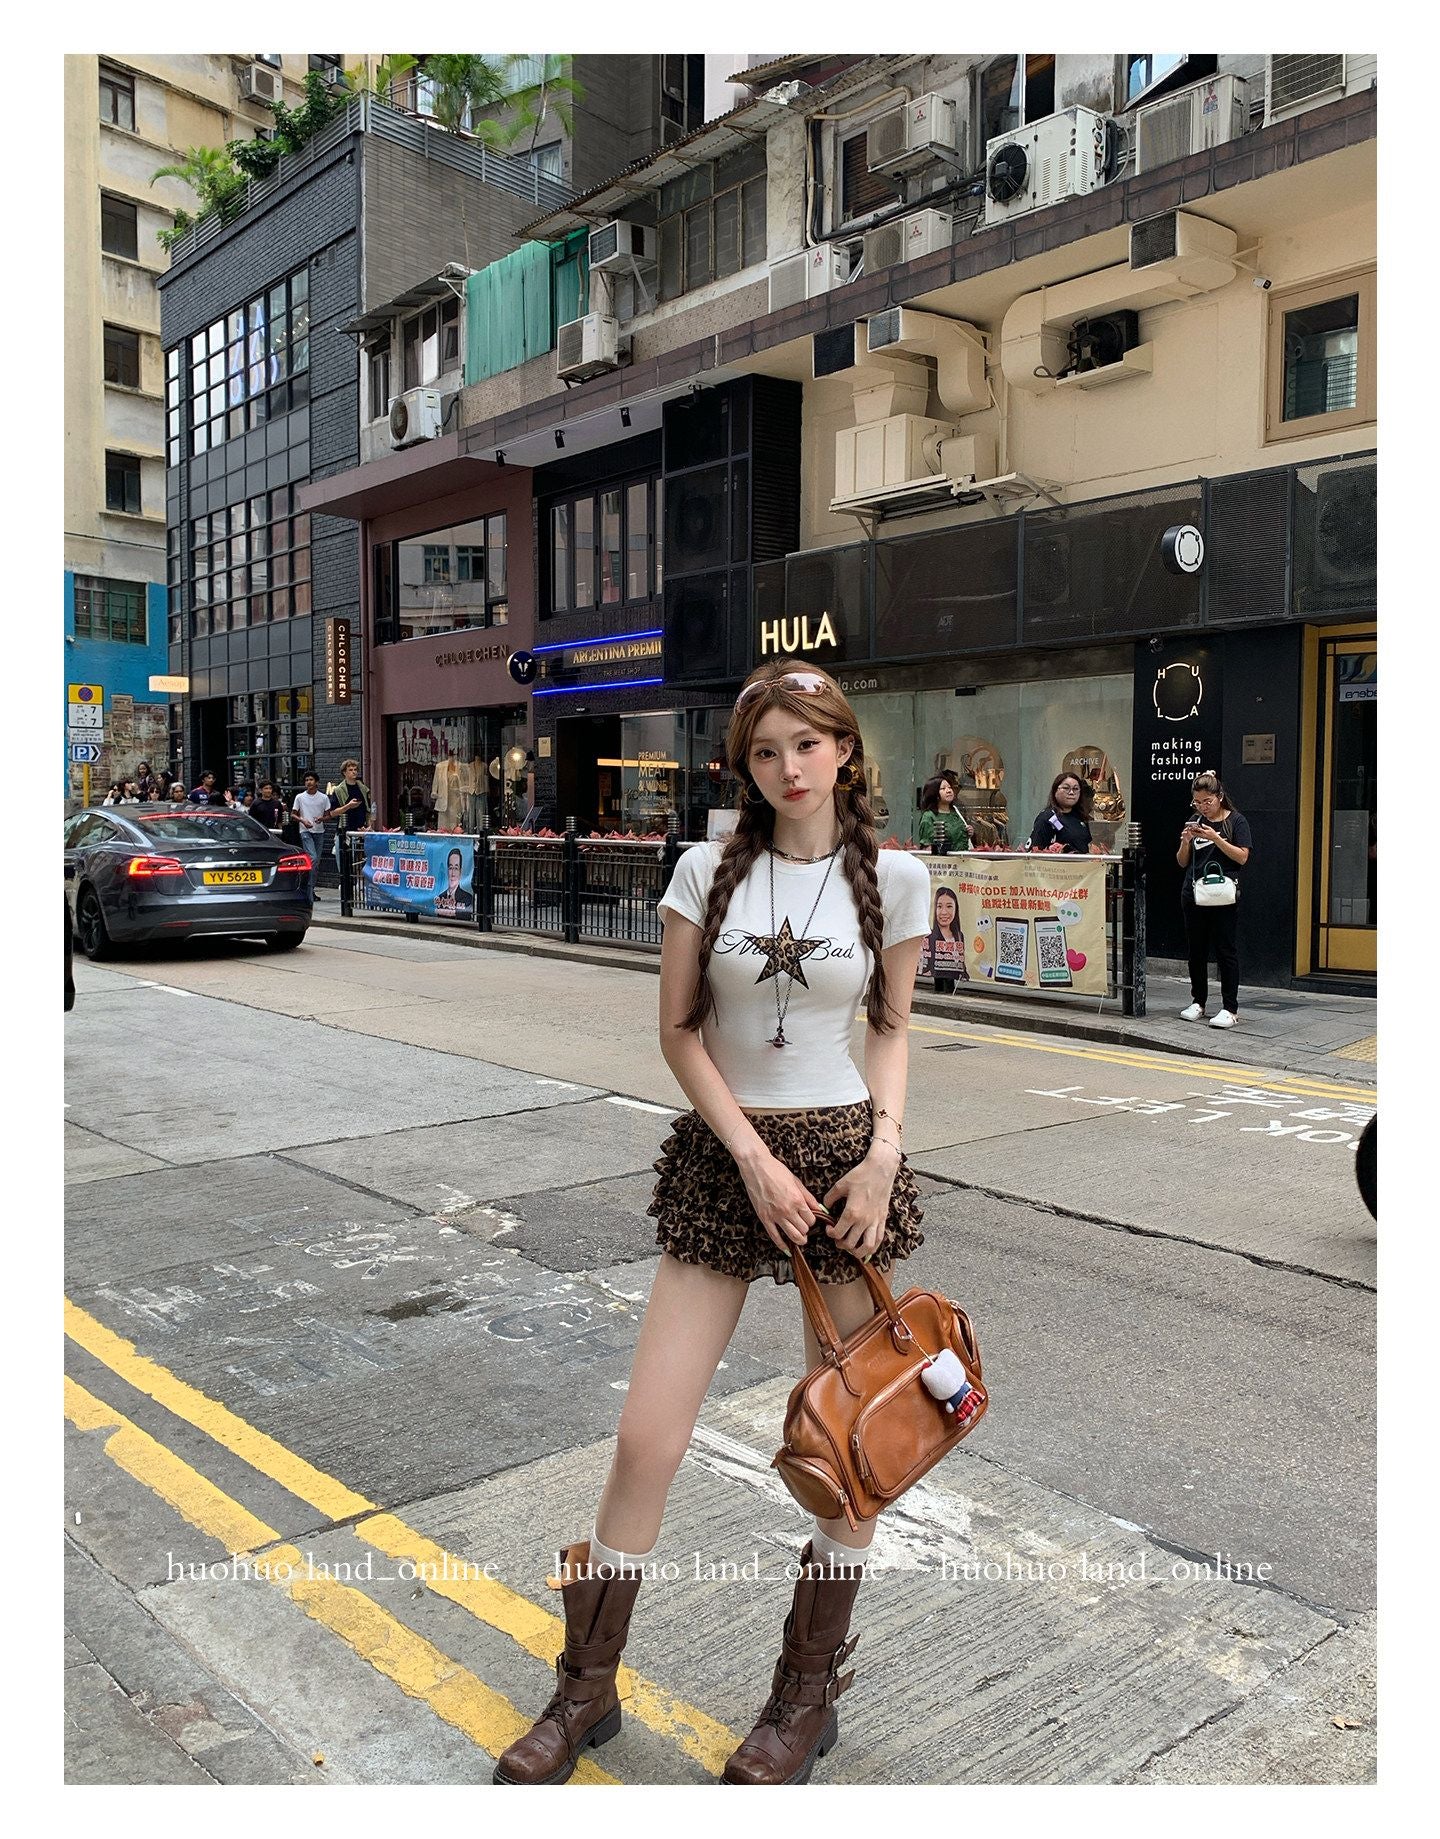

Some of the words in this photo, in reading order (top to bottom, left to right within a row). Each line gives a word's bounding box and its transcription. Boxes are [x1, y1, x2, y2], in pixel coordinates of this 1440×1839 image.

[761, 611, 837, 654] HULA
[338, 625, 347, 698] CHLOECHEN
[572, 647, 626, 664] ARGENTINA
[837, 677, 877, 691] la.com
[90, 706, 96, 714] 7
[90, 718, 96, 726] 7
[1151, 738, 1201, 751] making
[76, 747, 88, 759] P
[638, 751, 667, 760] PREMIUM
[1151, 753, 1201, 765] fashion
[1070, 757, 1100, 766] ARCHIVE
[638, 763, 666, 778] MEAT
[209, 872, 224, 882] YV
[227, 872, 257, 882] 5628
[798, 936, 856, 961] Bad
[1024, 1086, 1233, 1123] LEFT
[1239, 1120, 1361, 1150] OK
